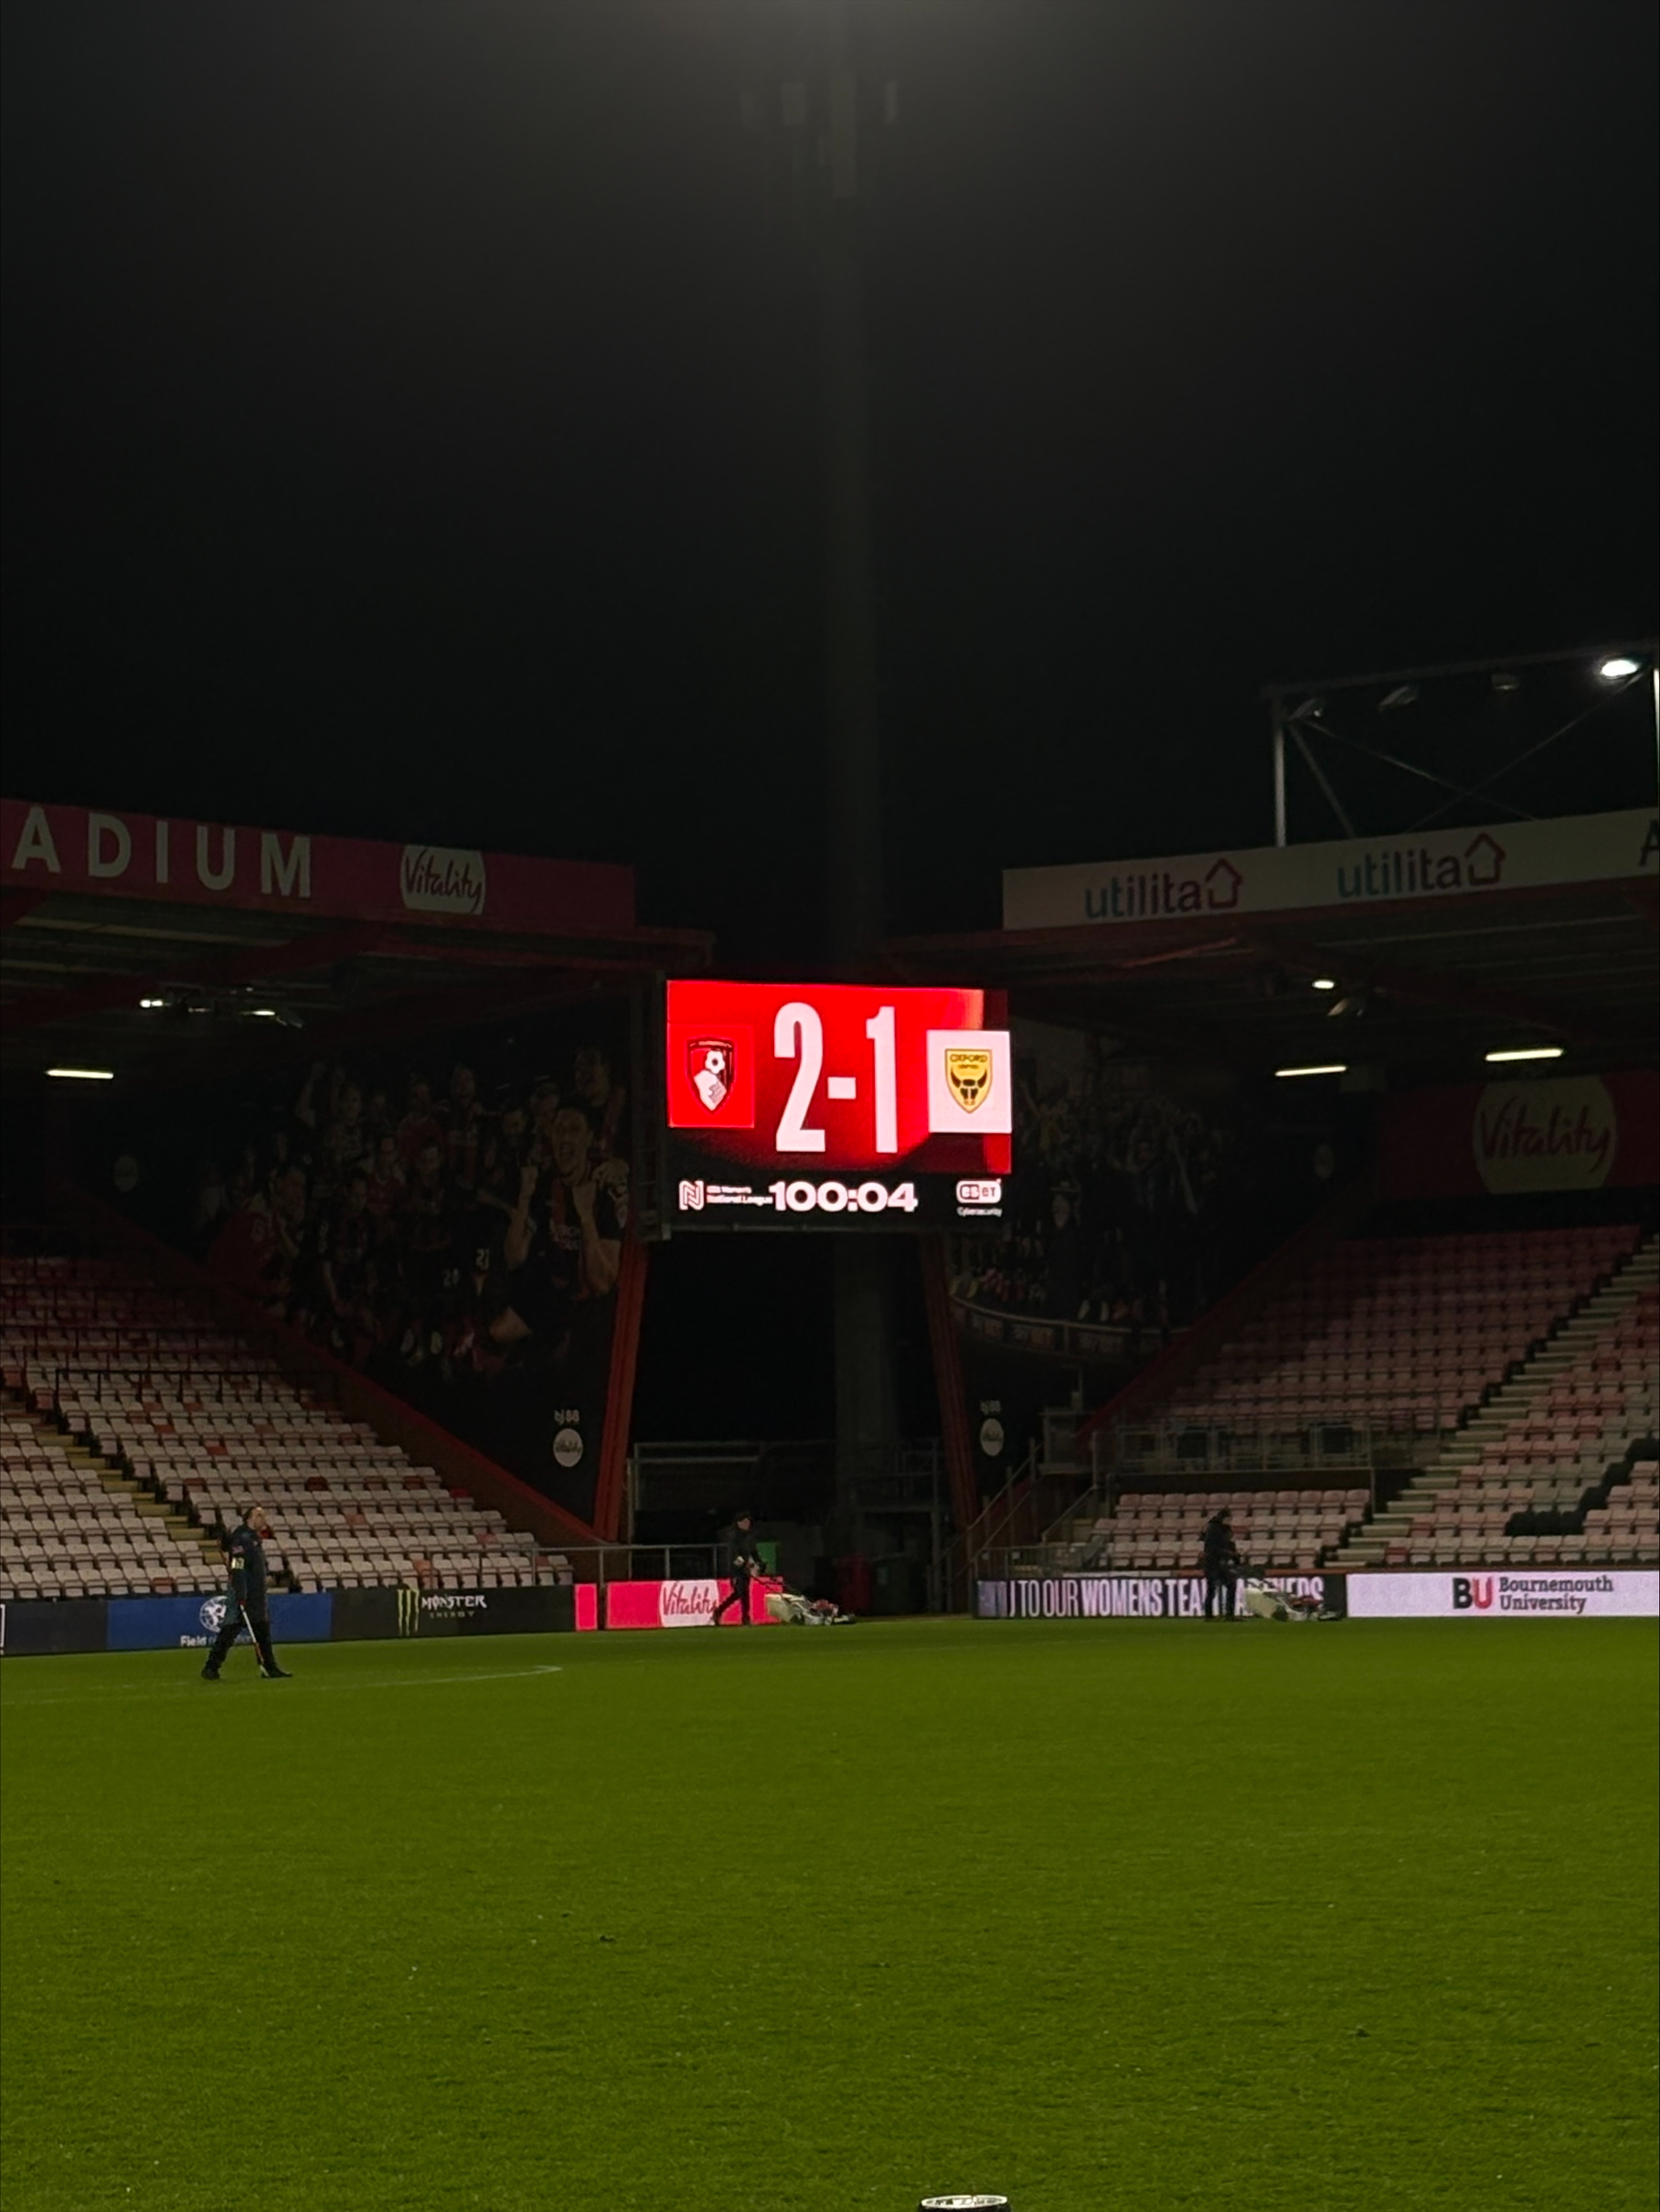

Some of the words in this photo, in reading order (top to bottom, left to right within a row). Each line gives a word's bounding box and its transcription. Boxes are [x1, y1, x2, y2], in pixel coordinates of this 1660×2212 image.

[406, 847, 482, 914] Vitality
[1337, 848, 1461, 898] utilita
[1085, 873, 1200, 919] utilita
[1481, 1096, 1610, 1175] Vitality
[769, 1181, 918, 1211] 100:04
[1017, 1579, 1040, 1617] TO
[1042, 1579, 1080, 1617] OUR
[1080, 1579, 1164, 1617] WOMENS
[1452, 1577, 1493, 1610] BU
[1498, 1575, 1613, 1592] Bournemouth
[421, 1594, 487, 1611] MONSTER
[430, 1611, 475, 1619] ENERGY
[1500, 1594, 1587, 1614] University
[180, 1634, 207, 1647] Field
